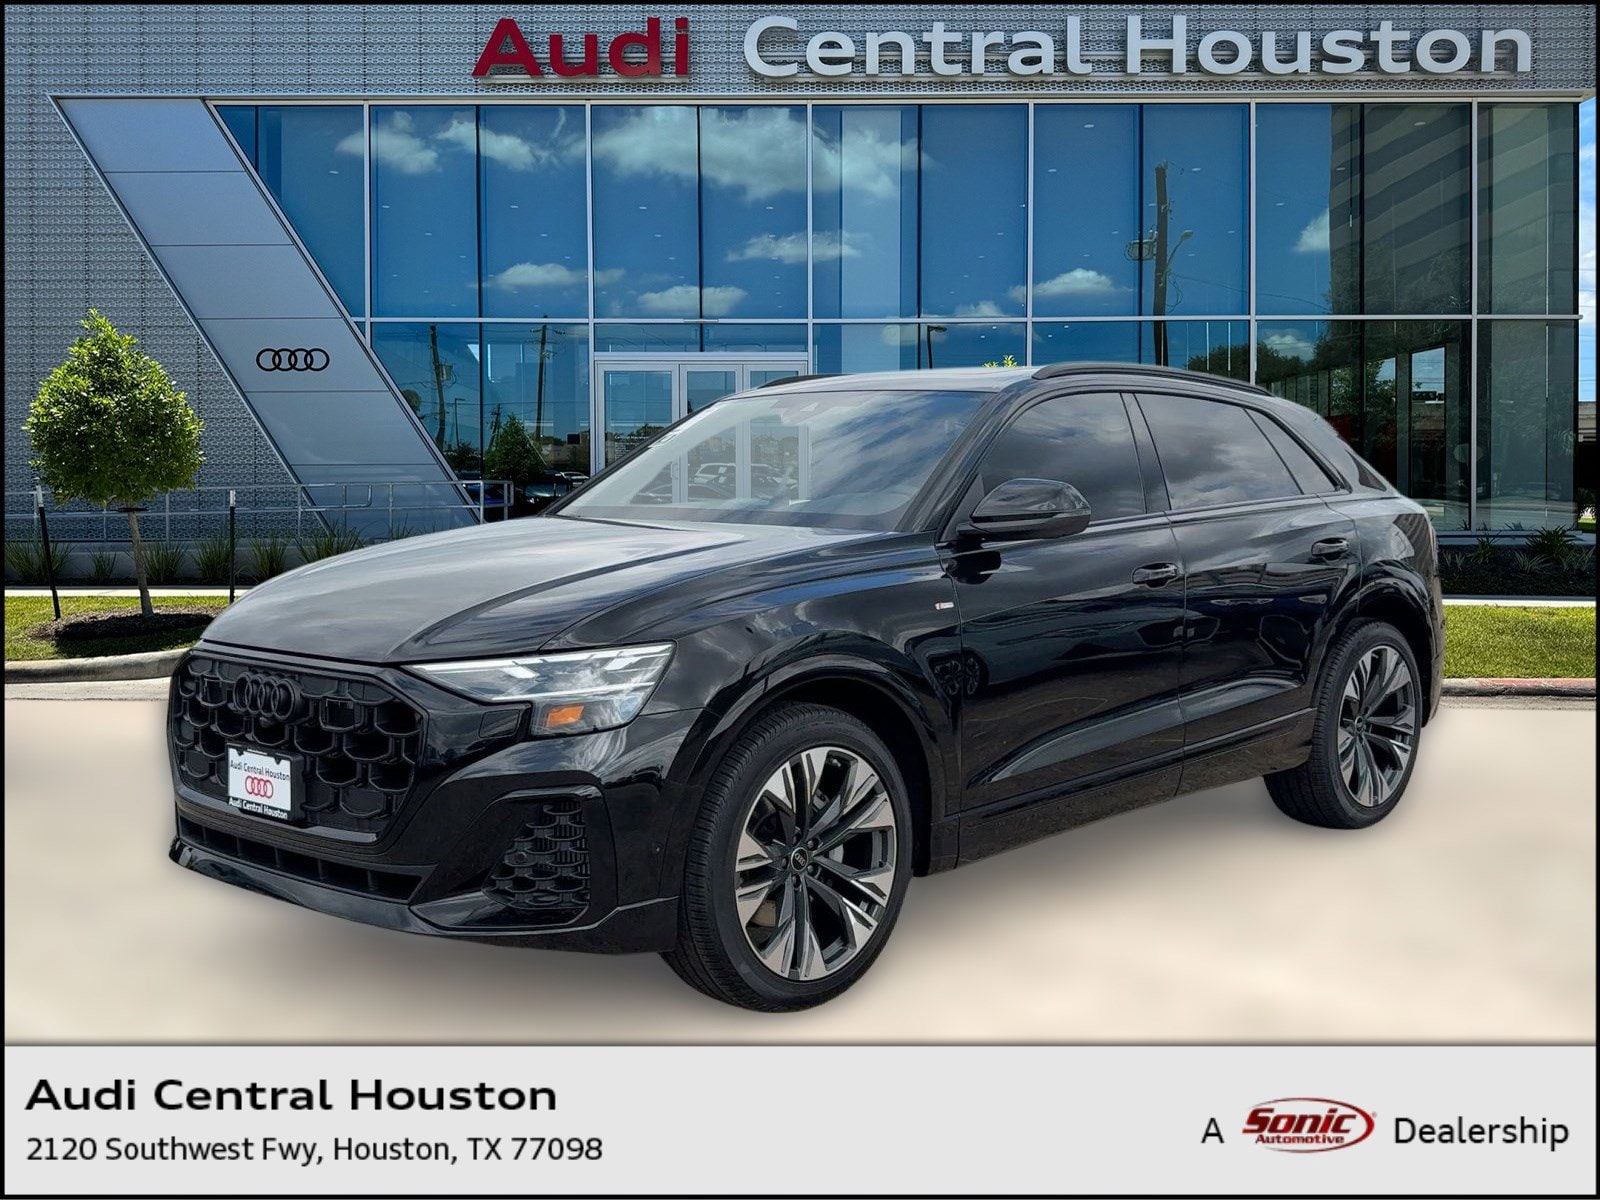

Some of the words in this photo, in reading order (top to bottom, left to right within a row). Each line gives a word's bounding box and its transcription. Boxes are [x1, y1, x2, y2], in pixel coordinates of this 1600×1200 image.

[472, 16, 690, 79] Audi
[743, 15, 1093, 77] Central
[1126, 14, 1533, 76] Houston
[230, 759, 243, 770] Audi
[243, 762, 264, 775] Central
[264, 767, 290, 781] Houston
[228, 797, 242, 809] Audi
[242, 799, 263, 814] Central
[263, 805, 288, 820] Houston
